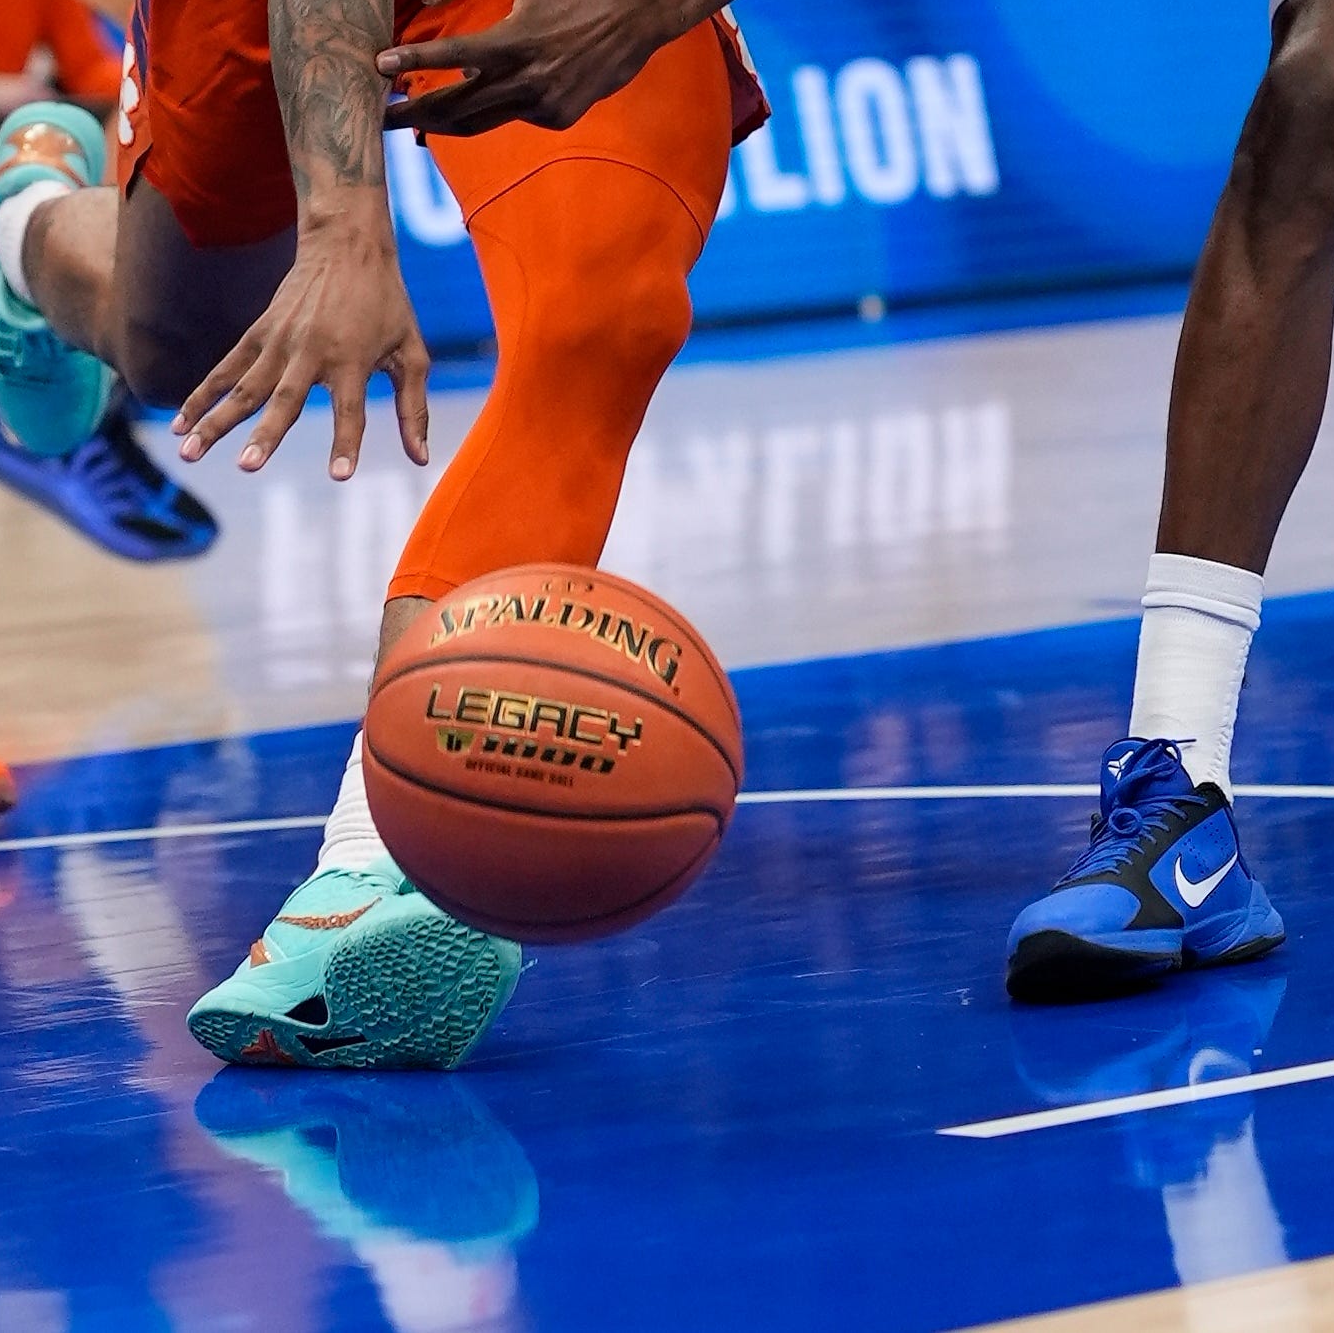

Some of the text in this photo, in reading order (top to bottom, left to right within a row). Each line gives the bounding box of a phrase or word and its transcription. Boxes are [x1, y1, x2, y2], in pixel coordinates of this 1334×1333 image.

[716, 53, 1001, 221] LION
[428, 592, 683, 690] SPALDING
[424, 681, 644, 756] LEGACY
